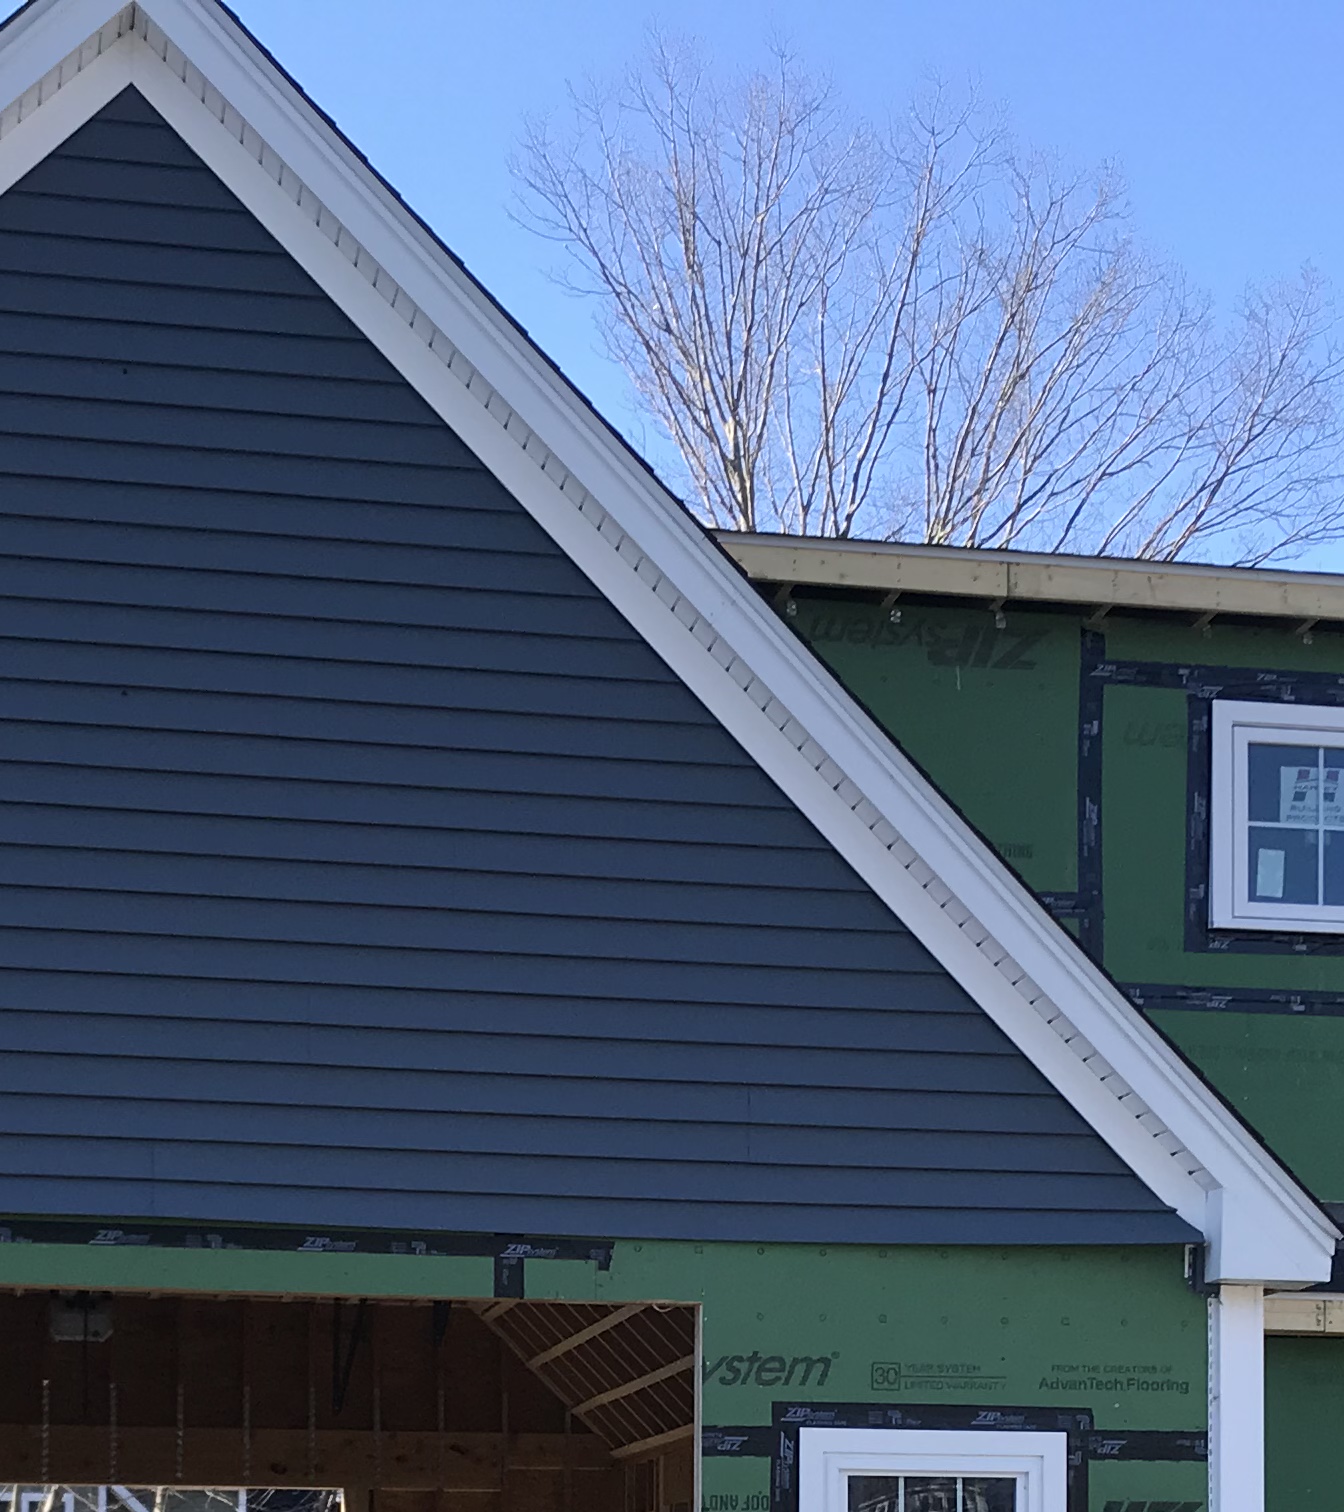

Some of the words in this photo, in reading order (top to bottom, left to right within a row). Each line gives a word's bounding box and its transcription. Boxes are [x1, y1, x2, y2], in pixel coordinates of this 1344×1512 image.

[874, 1366, 898, 1385] 30
[1038, 1376, 1125, 1392] AdvanTech
[1126, 1377, 1190, 1395] Flooring
[709, 1494, 740, 1512] AND
